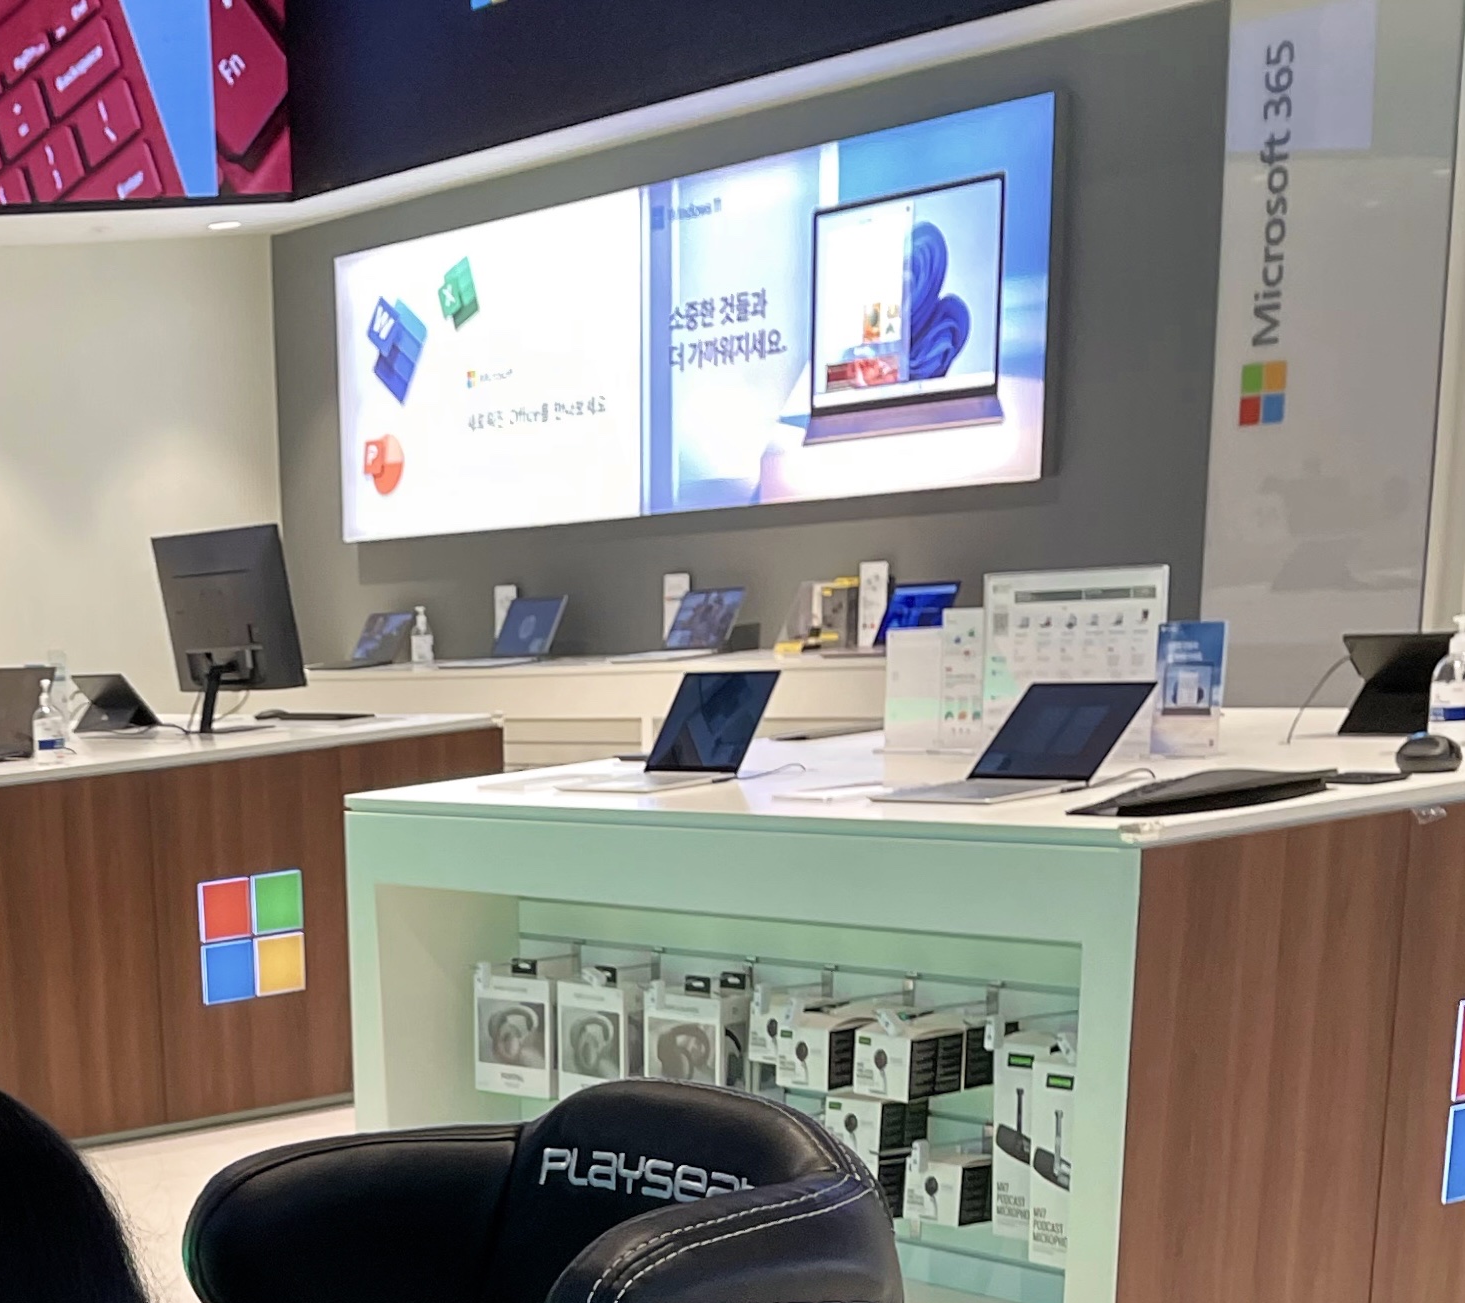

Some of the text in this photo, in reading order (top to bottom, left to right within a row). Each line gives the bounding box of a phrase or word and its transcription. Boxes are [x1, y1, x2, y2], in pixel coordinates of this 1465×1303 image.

[218, 54, 246, 86] Fn
[1251, 39, 1295, 347] Microsoft 365
[668, 287, 768, 332] 소중한 것들과
